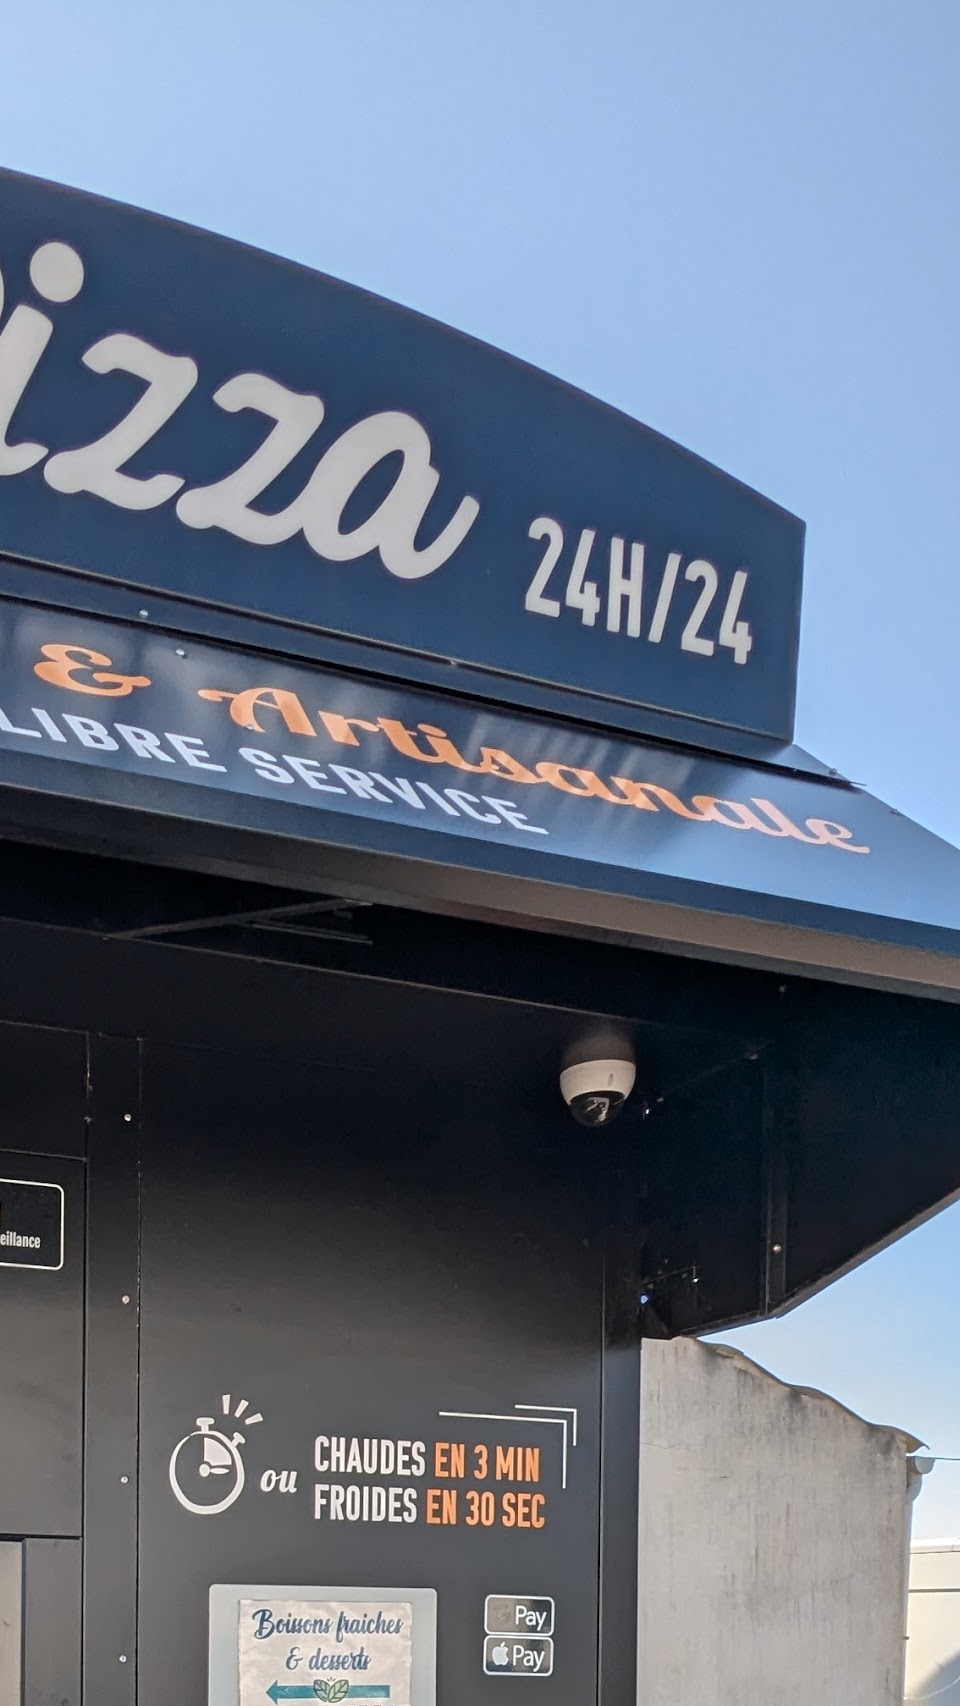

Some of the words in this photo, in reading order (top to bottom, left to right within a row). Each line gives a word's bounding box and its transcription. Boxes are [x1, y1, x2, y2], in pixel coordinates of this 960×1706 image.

[522, 516, 752, 665] 24H/24
[34, 643, 152, 697] &
[197, 687, 870, 854] Artisanale
[239, 746, 549, 835] SERVICE
[313, 1434, 427, 1477] CHAUDES
[434, 1441, 465, 1479] EN
[473, 1444, 489, 1480] 3
[495, 1445, 541, 1483] MIN
[259, 1468, 298, 1494] ou
[313, 1484, 418, 1524] FROIDES
[426, 1488, 457, 1526] EN
[465, 1490, 495, 1528] 30
[501, 1493, 546, 1529] SEC
[251, 1608, 333, 1640] Boissons
[335, 1610, 404, 1643] fraiches
[515, 1605, 548, 1632] Pay
[285, 1646, 303, 1671] &
[308, 1647, 372, 1671] desserts
[512, 1644, 546, 1672] Pay
